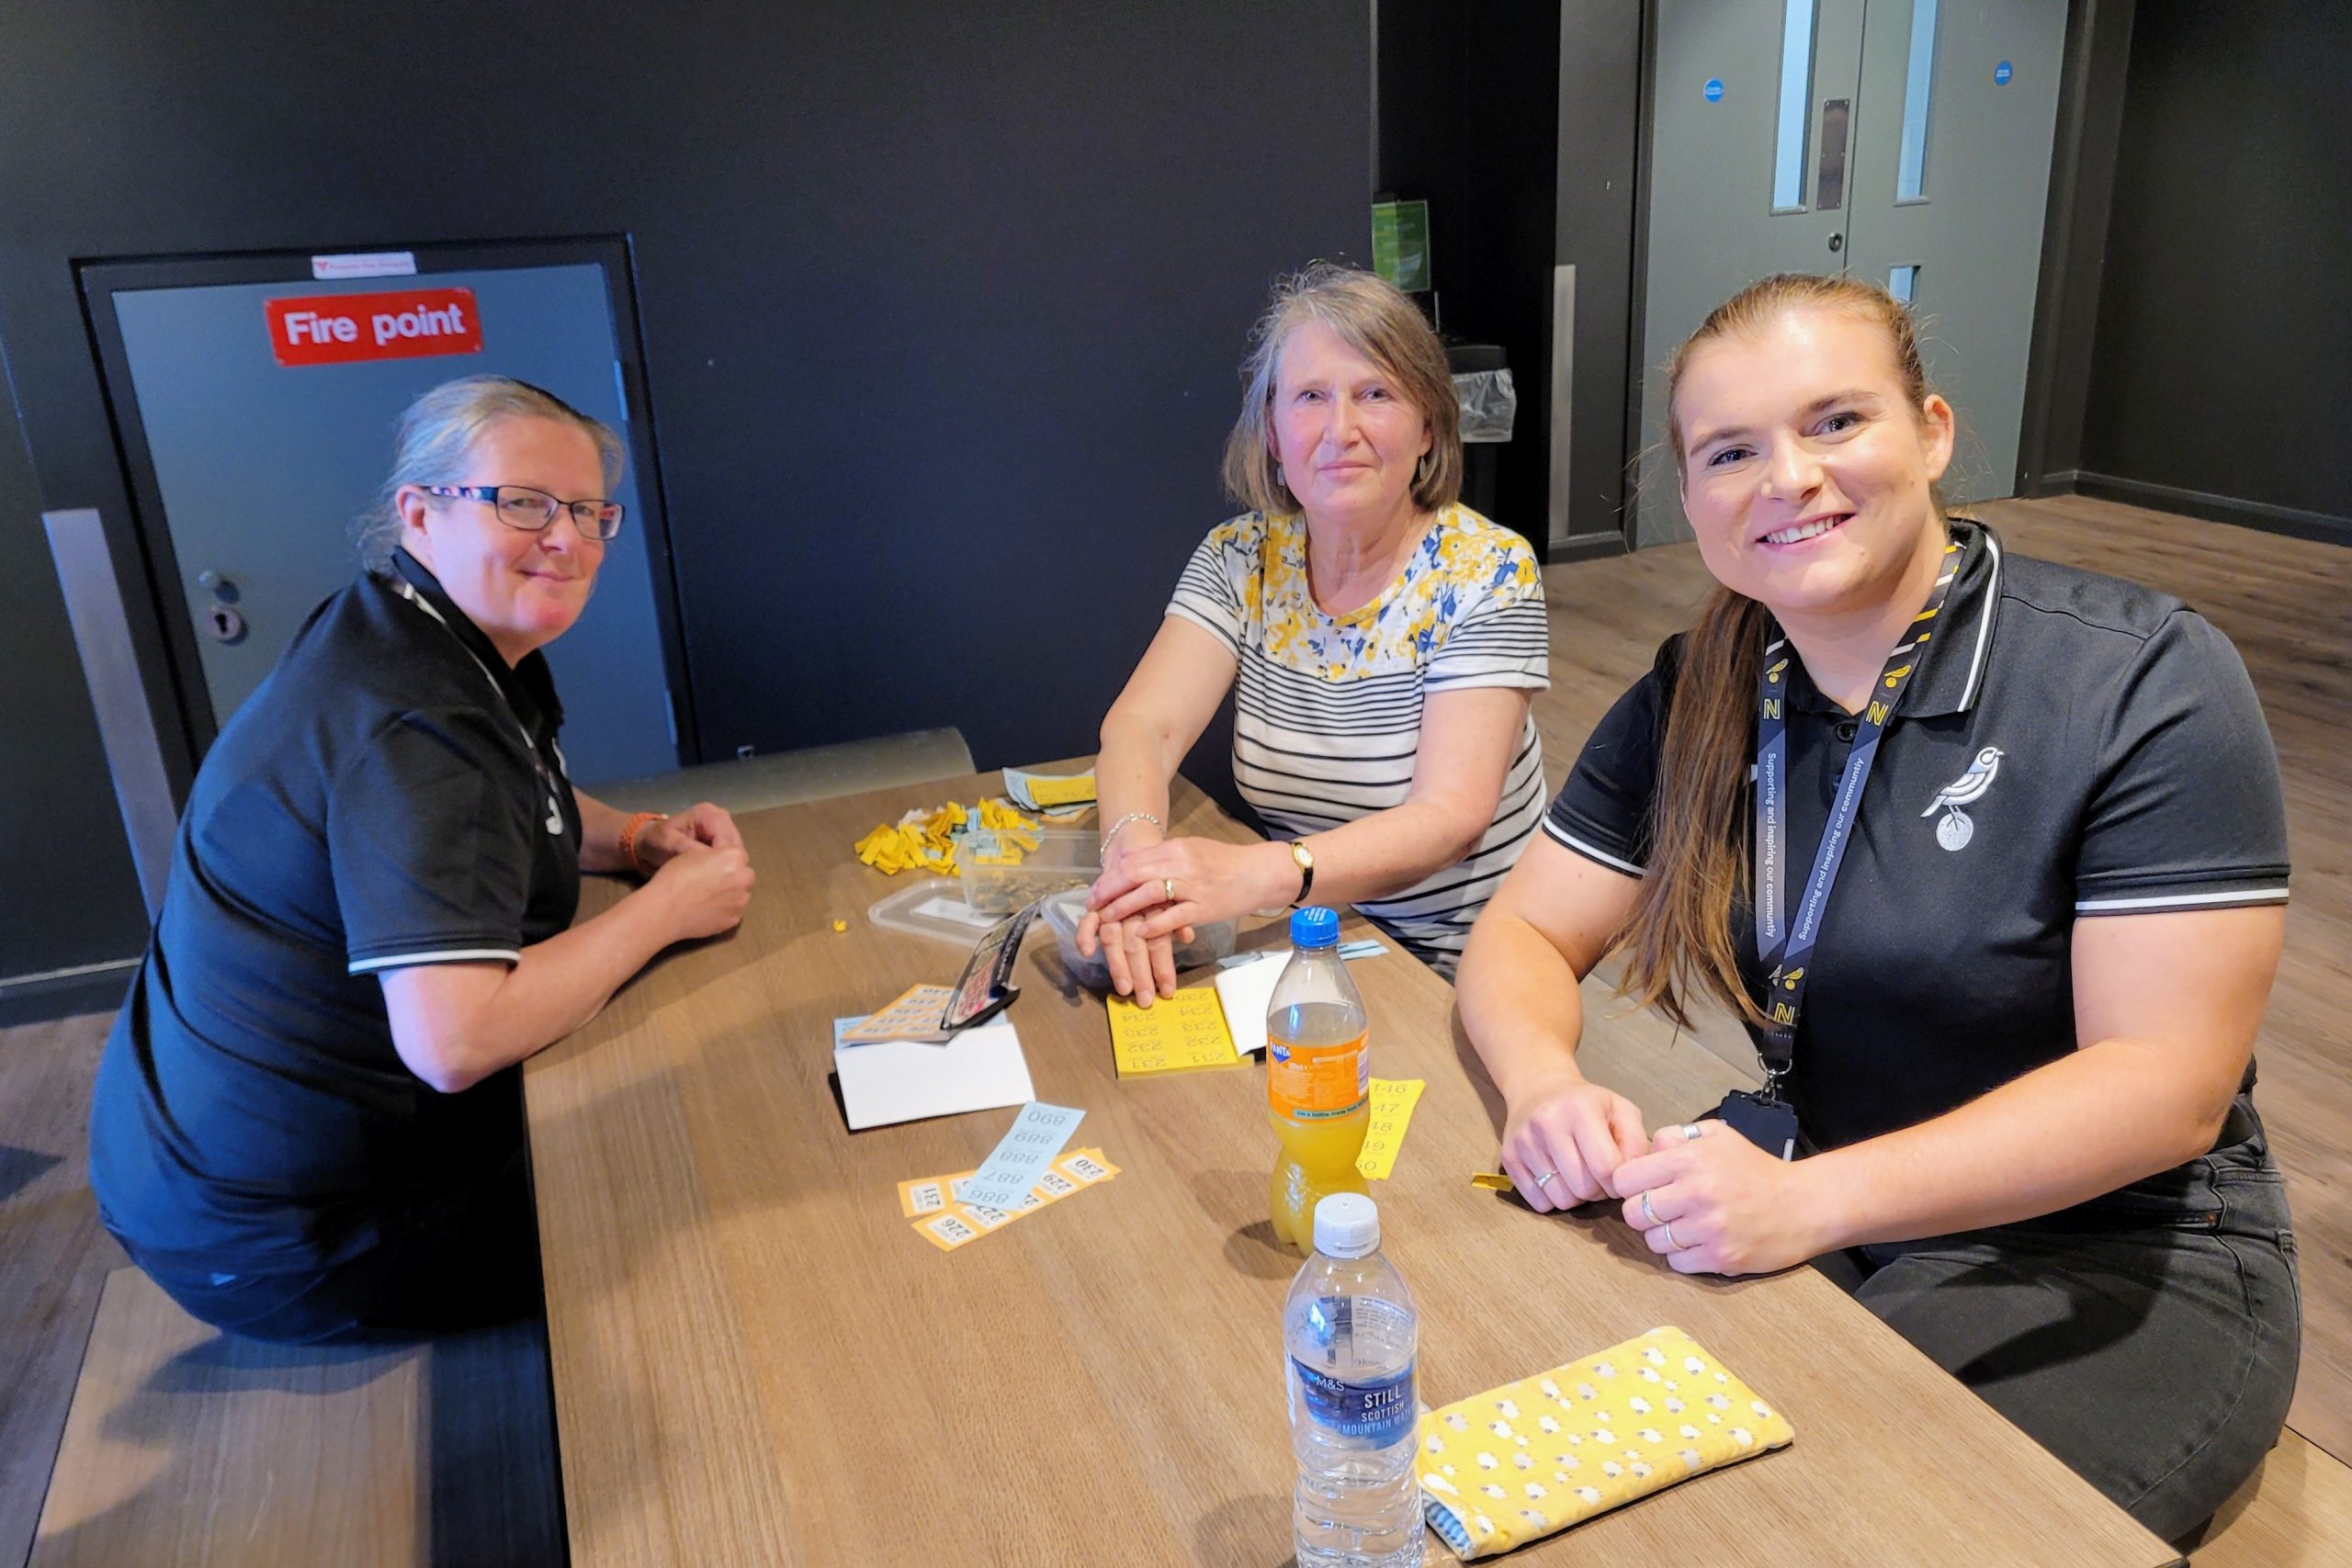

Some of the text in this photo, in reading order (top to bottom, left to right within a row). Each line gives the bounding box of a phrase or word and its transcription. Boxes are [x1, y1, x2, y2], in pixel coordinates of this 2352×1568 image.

[284, 302, 467, 346] Fire point
[1763, 699, 1781, 720] N
[1866, 701, 1889, 727] N
[1765, 752, 1776, 805] Supporting
[1766, 807, 1776, 824] and
[1836, 812, 1846, 829] our
[1764, 825, 1776, 865] inspiring
[1820, 829, 1842, 872] inspiring
[1766, 867, 1774, 882] our
[1816, 870, 1826, 889] and
[1798, 888, 1822, 941] Supporting
[1123, 1011, 1157, 1022] 234
[1179, 1007, 1214, 1017] 234
[1774, 1002, 1795, 1026] N
[1124, 1026, 1159, 1037] 233
[1182, 1021, 1217, 1032] 233
[1126, 1041, 1163, 1052] 232
[1186, 1036, 1222, 1047] 232
[1132, 1057, 1166, 1069] 231
[1192, 1053, 1227, 1064] 231
[1374, 1083, 1408, 1093] 146
[1374, 1103, 1400, 1113] 47
[1028, 1110, 1066, 1126] 890
[1014, 1132, 1053, 1145] 889
[1000, 1150, 1039, 1165] 888
[1075, 1159, 1104, 1176] 230
[982, 1170, 1023, 1184] 887
[1043, 1174, 1072, 1190] 229
[923, 1188, 942, 1207] 231
[969, 1189, 1010, 1204] 886
[941, 1218, 971, 1237] 226
[1317, 1376, 1345, 1392] M&S
[1364, 1385, 1401, 1409] STILL
[1362, 1400, 1404, 1422] SCOTTISH
[1342, 1419, 1391, 1435] MOUNTAIN
